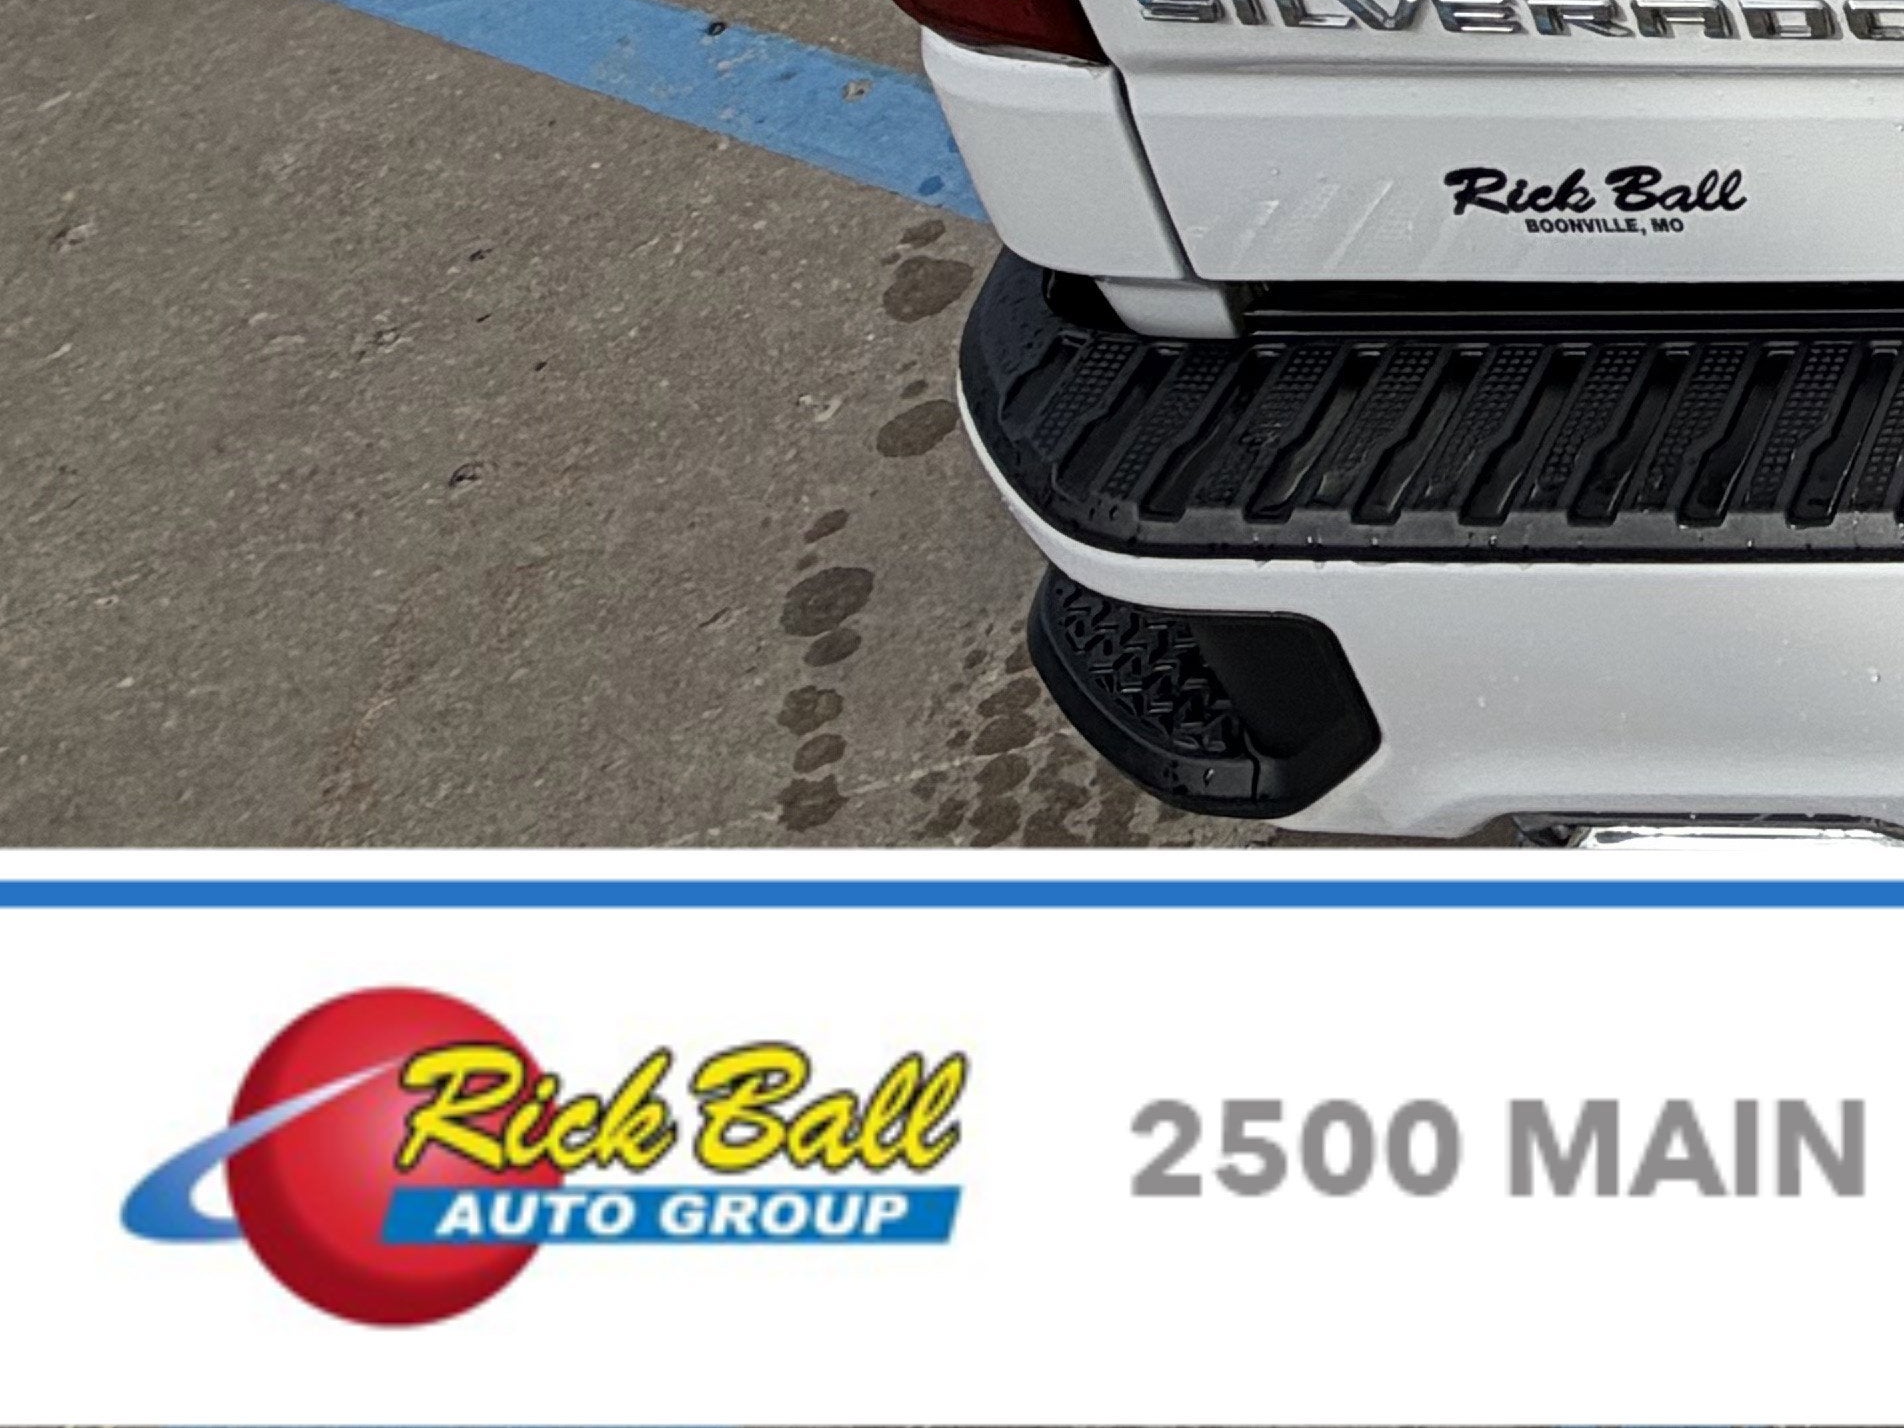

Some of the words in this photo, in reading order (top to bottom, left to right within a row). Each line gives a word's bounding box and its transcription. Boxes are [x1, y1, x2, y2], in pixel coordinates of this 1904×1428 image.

[1444, 166, 1596, 215] Rick
[1605, 165, 1748, 213] Ball
[1525, 217, 1648, 236] BOONVILLE,
[1652, 218, 1685, 234] MO
